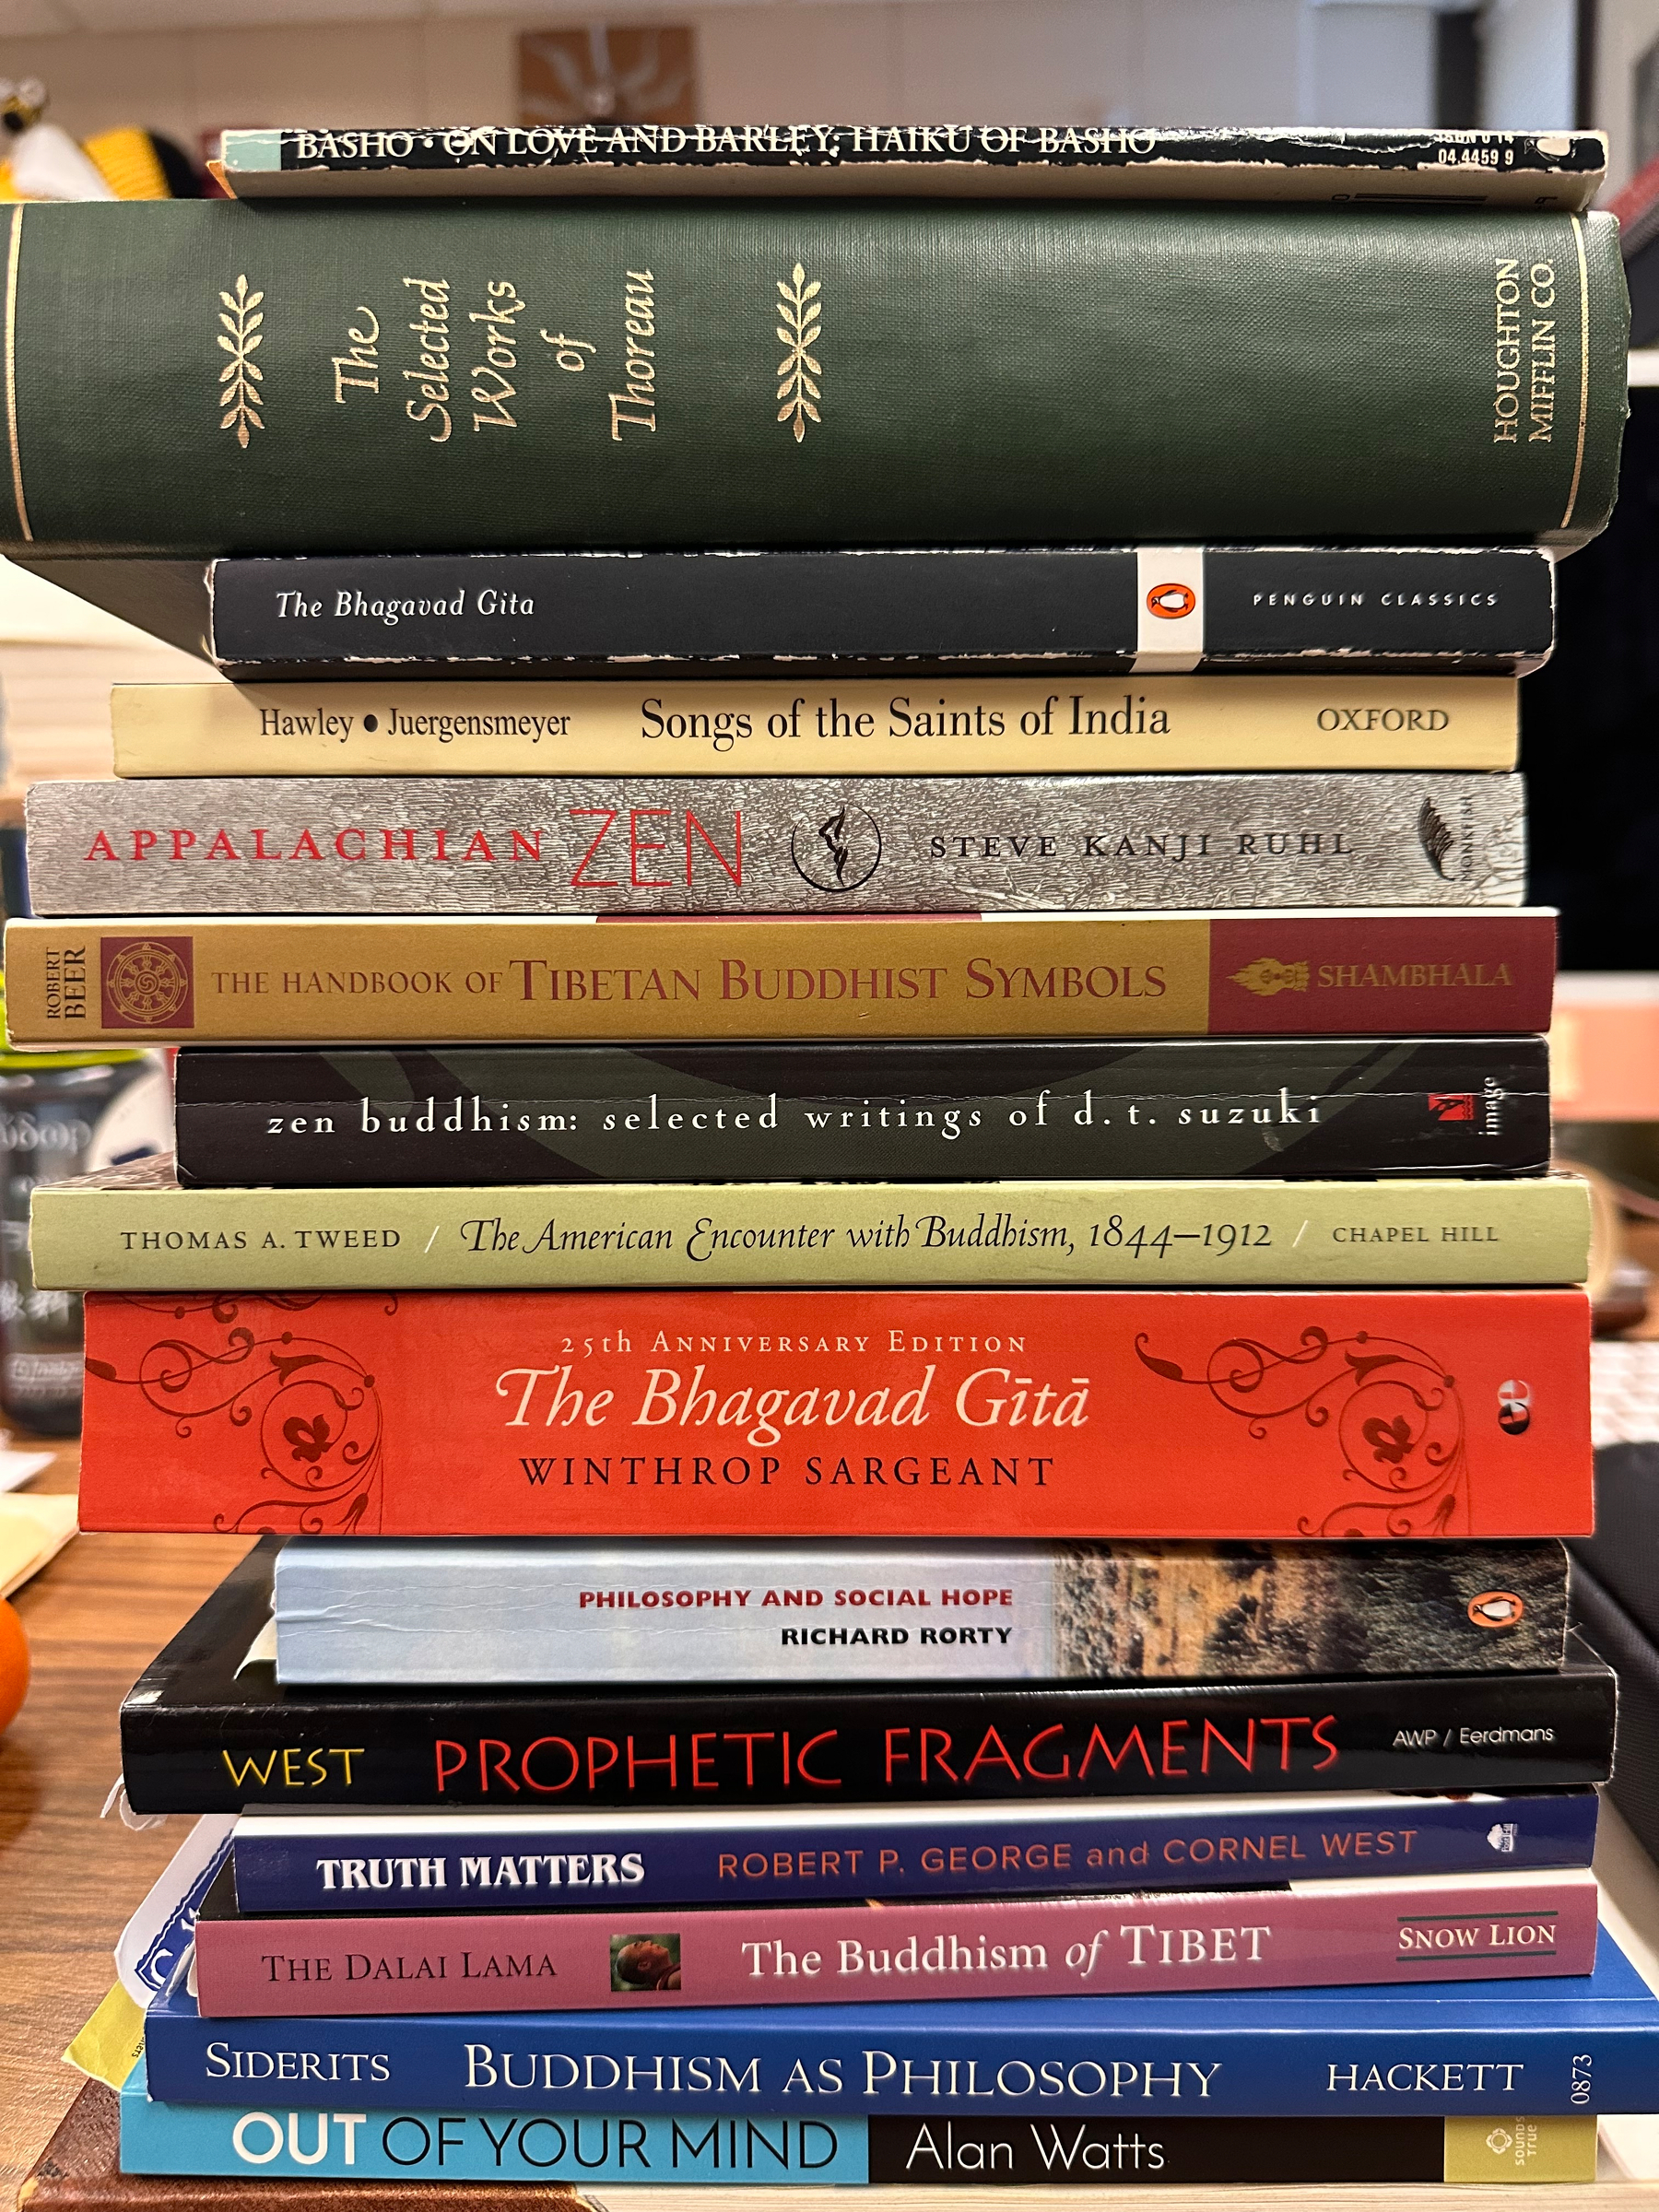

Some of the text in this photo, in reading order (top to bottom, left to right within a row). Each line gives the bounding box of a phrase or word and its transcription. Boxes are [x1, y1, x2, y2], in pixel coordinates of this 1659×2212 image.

[295, 131, 414, 159] BASHO
[443, 128, 497, 156] ON
[506, 127, 598, 156] LOVE
[606, 126, 688, 154] AND
[853, 127, 971, 153] HAIKU
[981, 127, 1028, 153] OF
[1039, 127, 1156, 154] BASHO
[1504, 148, 1514, 166] 9
[332, 306, 381, 405] The
[406, 276, 452, 442] Selected
[471, 280, 527, 434] Works
[539, 327, 597, 373] of
[610, 269, 657, 442] Thoreau
[1492, 257, 1519, 445] HOUGHTON
[1528, 258, 1557, 444] MIFFLIN CO.
[276, 590, 535, 626] The Bhagavad Gita
[1253, 592, 1500, 607] PENGUIN CLASSICS
[259, 708, 571, 743] Hawley Juergensmeyer
[641, 694, 1171, 753] Songs of the Saints of India
[1316, 709, 1450, 733] OXFORD
[84, 808, 743, 888] APPALACHIAN ZEN
[930, 832, 1354, 864] STEVE KANJI RUHL
[46, 947, 62, 1020] ROBERT
[64, 946, 87, 1020] BEER
[211, 957, 1168, 1002] THE HANDBOOK OF TIBETAN BUDDHIST SYMBOLS
[1317, 962, 1514, 988] SHAMBHALA
[266, 1088, 1322, 1139] zen buddhism: selected writings of d. t. suzuki
[1477, 1077, 1506, 1136] image
[121, 1230, 247, 1251] THOMAS
[262, 1230, 286, 1250] A.
[296, 1229, 402, 1249] TWEED
[460, 1218, 522, 1254] The
[522, 1219, 674, 1254] American
[686, 1217, 837, 1263] Encounter
[846, 1219, 912, 1251] with
[913, 1215, 1076, 1257] Buddhism,
[1089, 1215, 1273, 1259] 1844–1912
[1333, 1224, 1430, 1244] CHAPEL
[1441, 1223, 1500, 1243] HILL
[560, 1330, 1028, 1354] 25th ANNIVERSARY EDITION
[495, 1364, 1091, 1449] The Bhagavad Gītā
[519, 1456, 1055, 1488] WINTHROP SARGEANT
[579, 1588, 1014, 1609] PHILOSOPHY AND SOCIAL HOPE
[781, 1627, 1013, 1646] RICHARD RORTY
[223, 1747, 364, 1789] WEST
[435, 1727, 842, 1794] PROPHETIC
[883, 1714, 1339, 1785] FRAGMENTS
[1393, 1729, 1438, 1747] AWP
[1460, 1724, 1554, 1744] Eerdmans
[317, 1830, 1418, 1890] TRUTH MATTERS ROBERT P. GEORGE and CORNEL WEST
[741, 1923, 1271, 1977] The Buddhism of TIBET
[1397, 1922, 1556, 1950] SNOW LION
[262, 1949, 558, 1983] THE DALAI LAMA
[205, 2041, 1223, 2098] SIDERITS BUDDHISM AS PHILOSOPHY
[1325, 2063, 1524, 2092] HACKETT
[1570, 2053, 1593, 2105] 0873
[232, 2112, 838, 2170] OUT OF YOUR MIND
[905, 2122, 1165, 2171] Alan Watts
